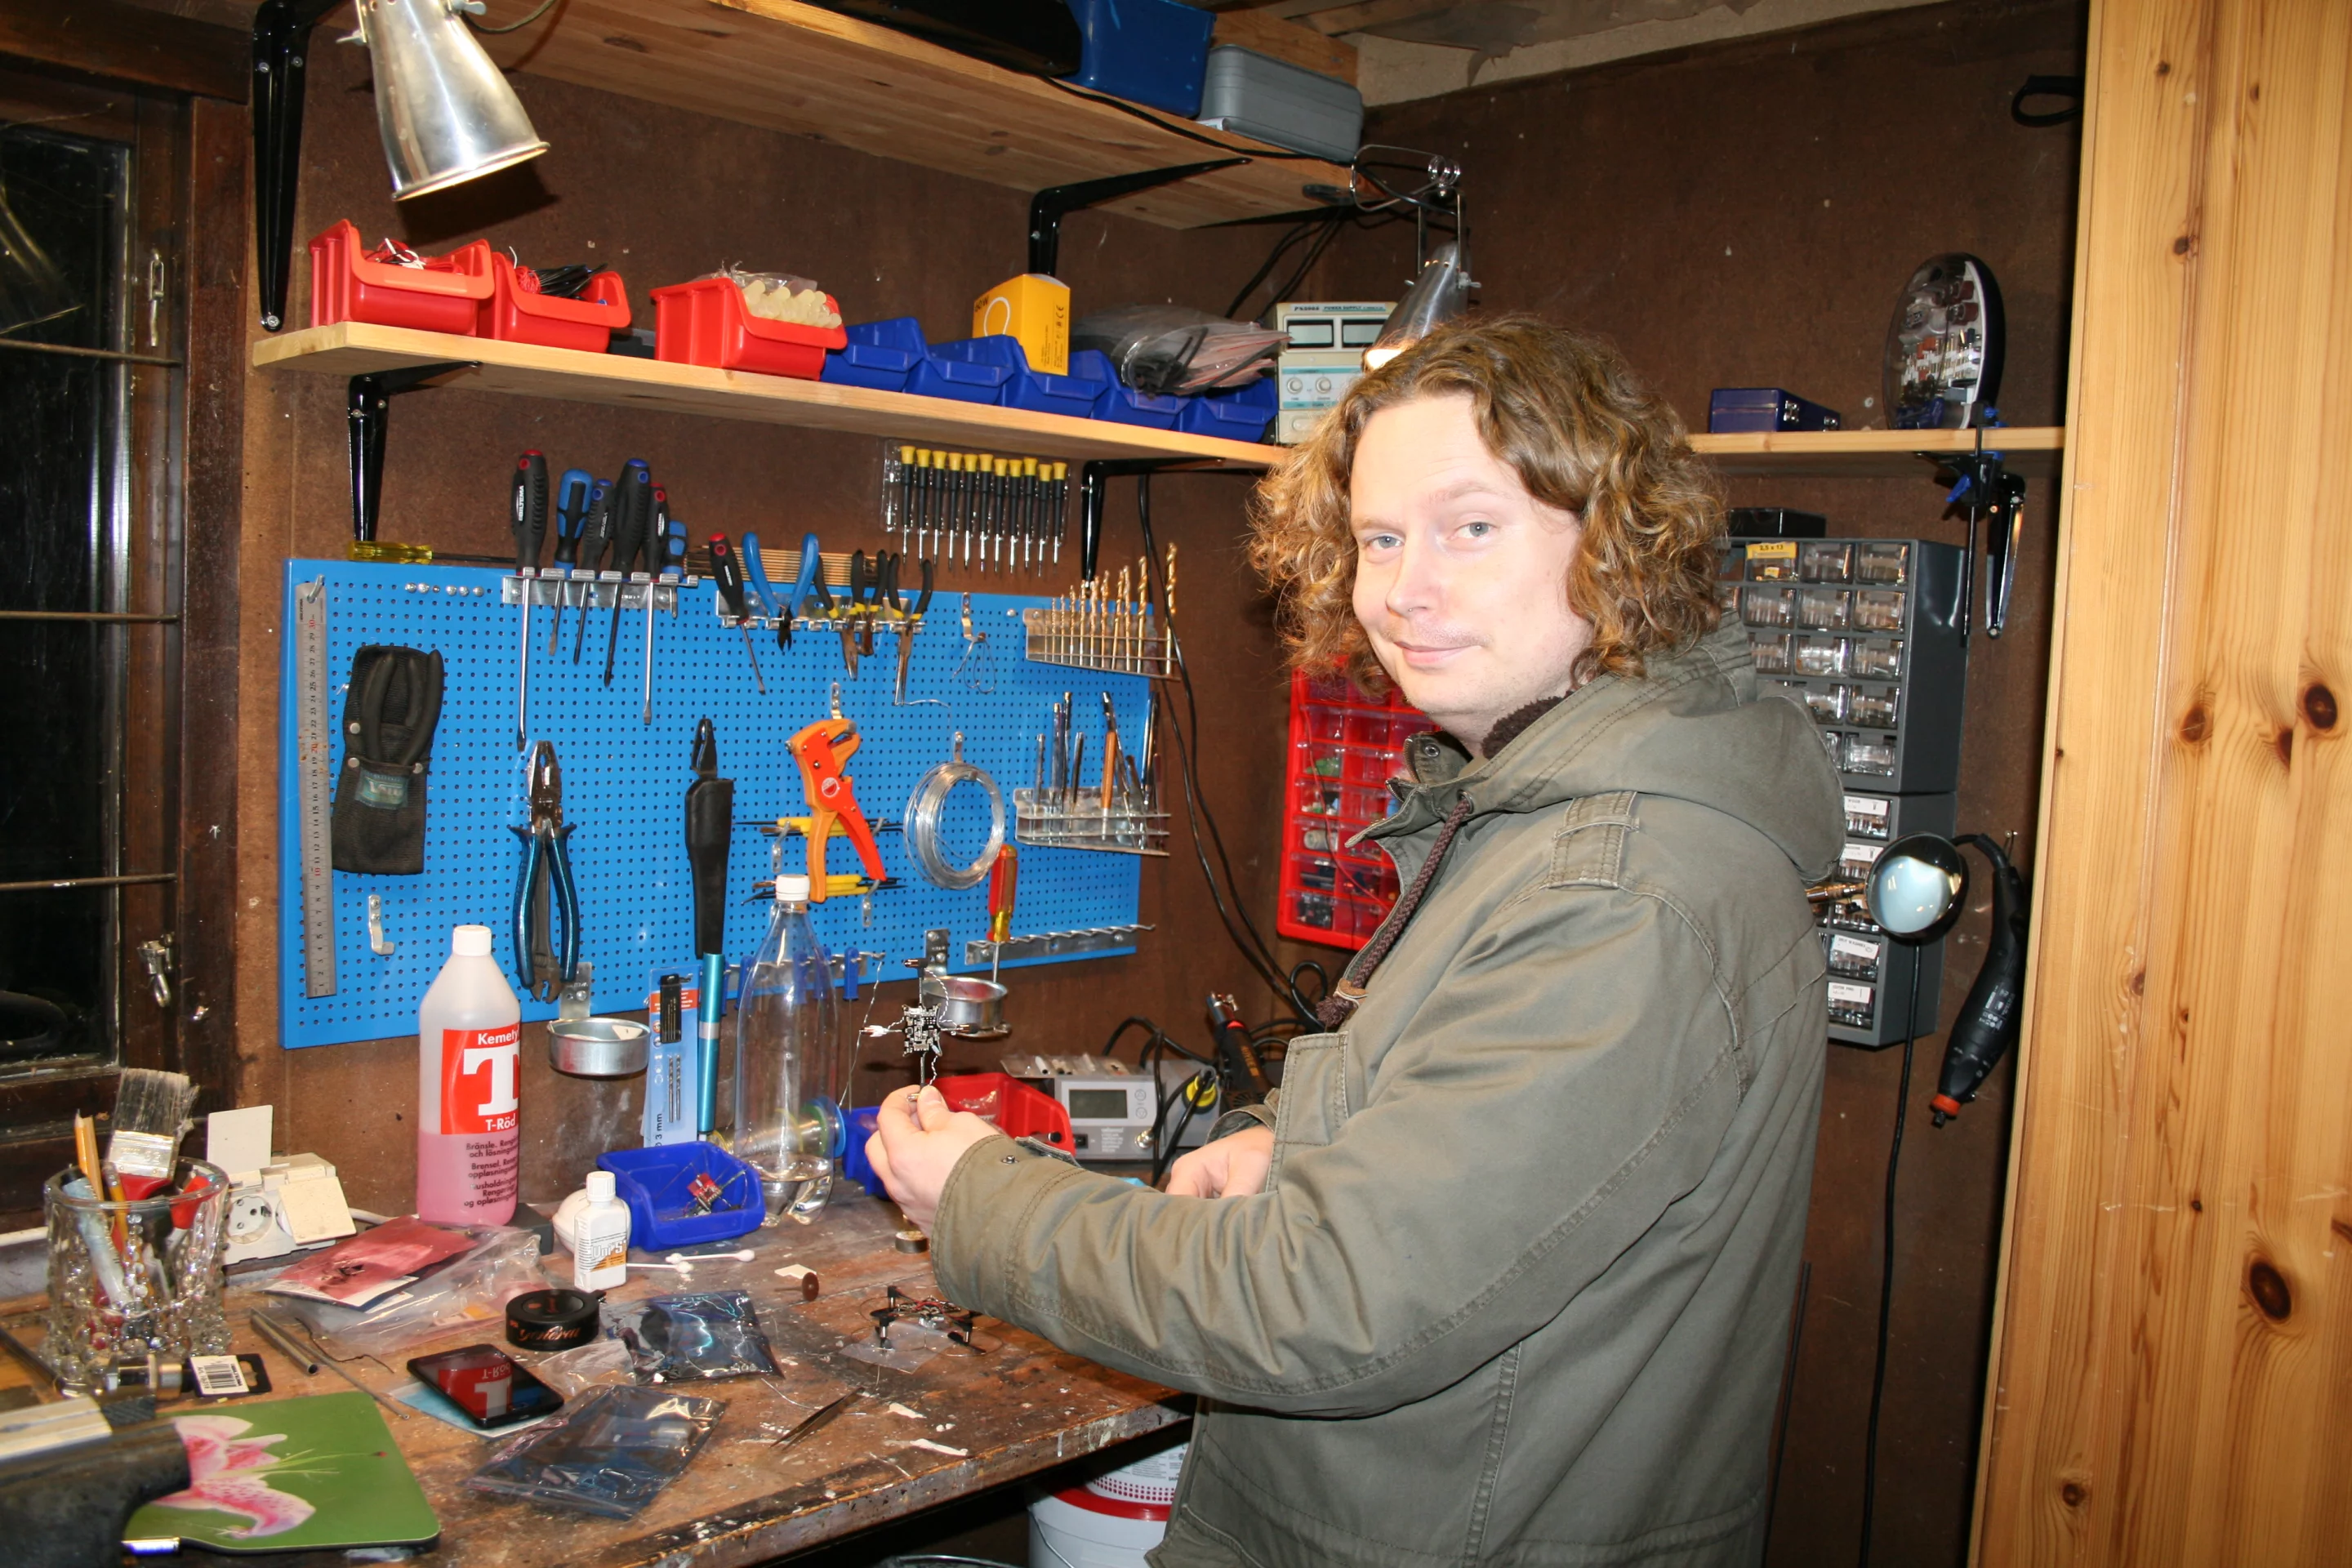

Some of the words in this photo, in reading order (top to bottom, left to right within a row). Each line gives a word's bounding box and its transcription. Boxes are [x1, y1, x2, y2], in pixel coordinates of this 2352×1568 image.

[309, 619, 316, 628] 30
[310, 645, 315, 653] 28
[310, 657, 315, 666] 27
[310, 670, 316, 678] 26
[310, 681, 317, 691] 25
[310, 707, 317, 715] 23
[310, 719, 317, 728] 22
[311, 743, 318, 753] 20
[312, 756, 318, 764] 19
[313, 805, 319, 814] 15
[314, 867, 321, 876] 10
[485, 1112, 516, 1132] T-Röd
[656, 1113, 663, 1131] mm
[466, 1140, 498, 1151] Bränsle.
[469, 1150, 483, 1158] och
[464, 1200, 474, 1208] og
